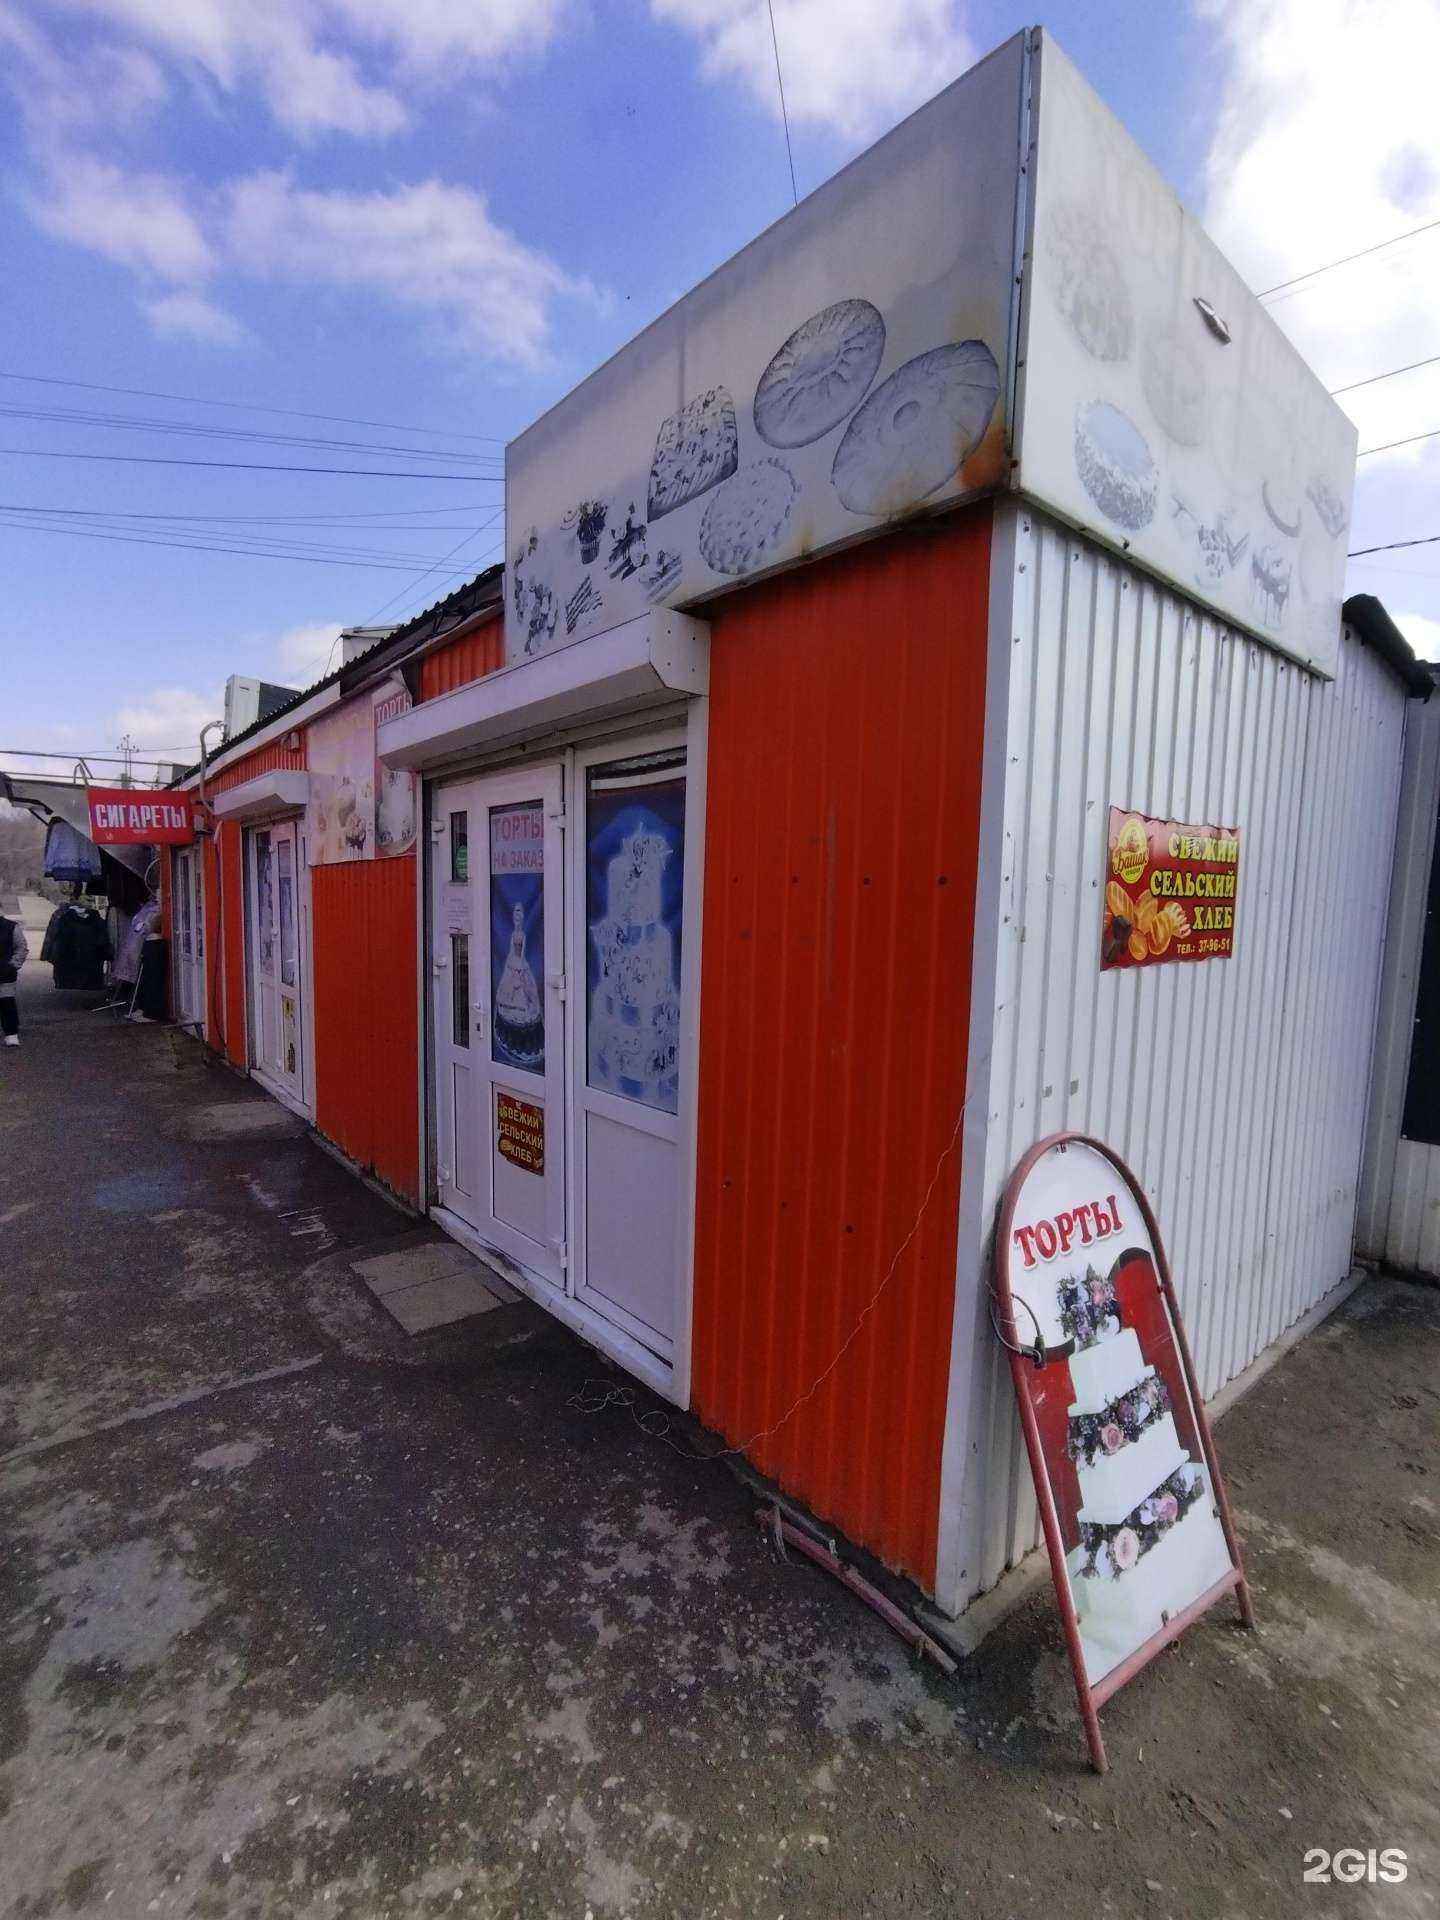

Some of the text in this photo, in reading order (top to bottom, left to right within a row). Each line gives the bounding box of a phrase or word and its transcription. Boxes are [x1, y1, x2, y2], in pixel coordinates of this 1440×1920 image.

[95, 804, 187, 828] СИГАРЕТЫ
[493, 812, 544, 841] ТОРТЫ
[1150, 870, 1236, 898] СЕЛЬСКИЙ
[1193, 906, 1233, 929] ХЛЕБ
[499, 1122, 544, 1150] СЕЛЬСКИЙ
[1014, 1194, 1123, 1268] ТОРТЫ
